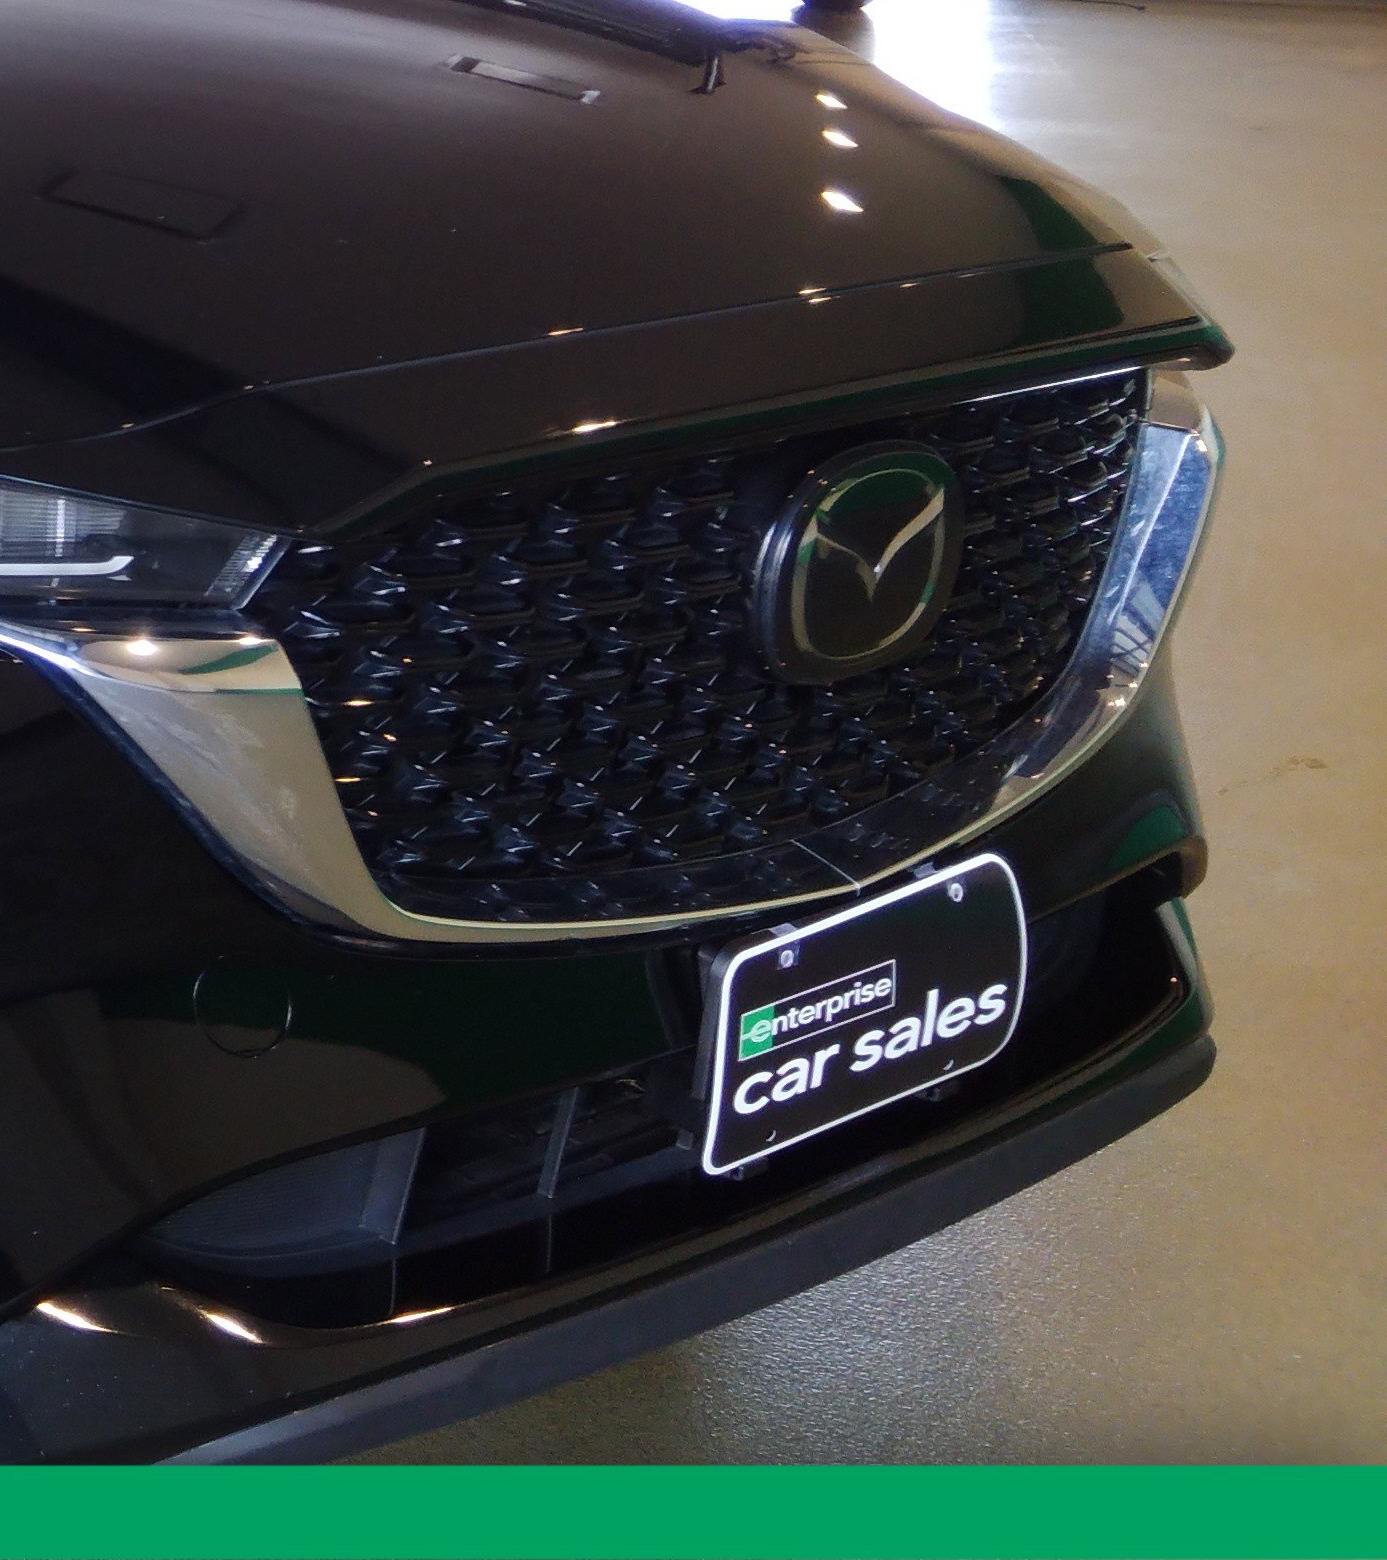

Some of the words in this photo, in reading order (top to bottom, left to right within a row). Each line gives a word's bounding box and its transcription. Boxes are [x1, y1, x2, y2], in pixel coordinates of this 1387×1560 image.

[733, 1042, 842, 1115] car
[850, 981, 1009, 1073] sales
[745, 976, 893, 1044] enterprise
